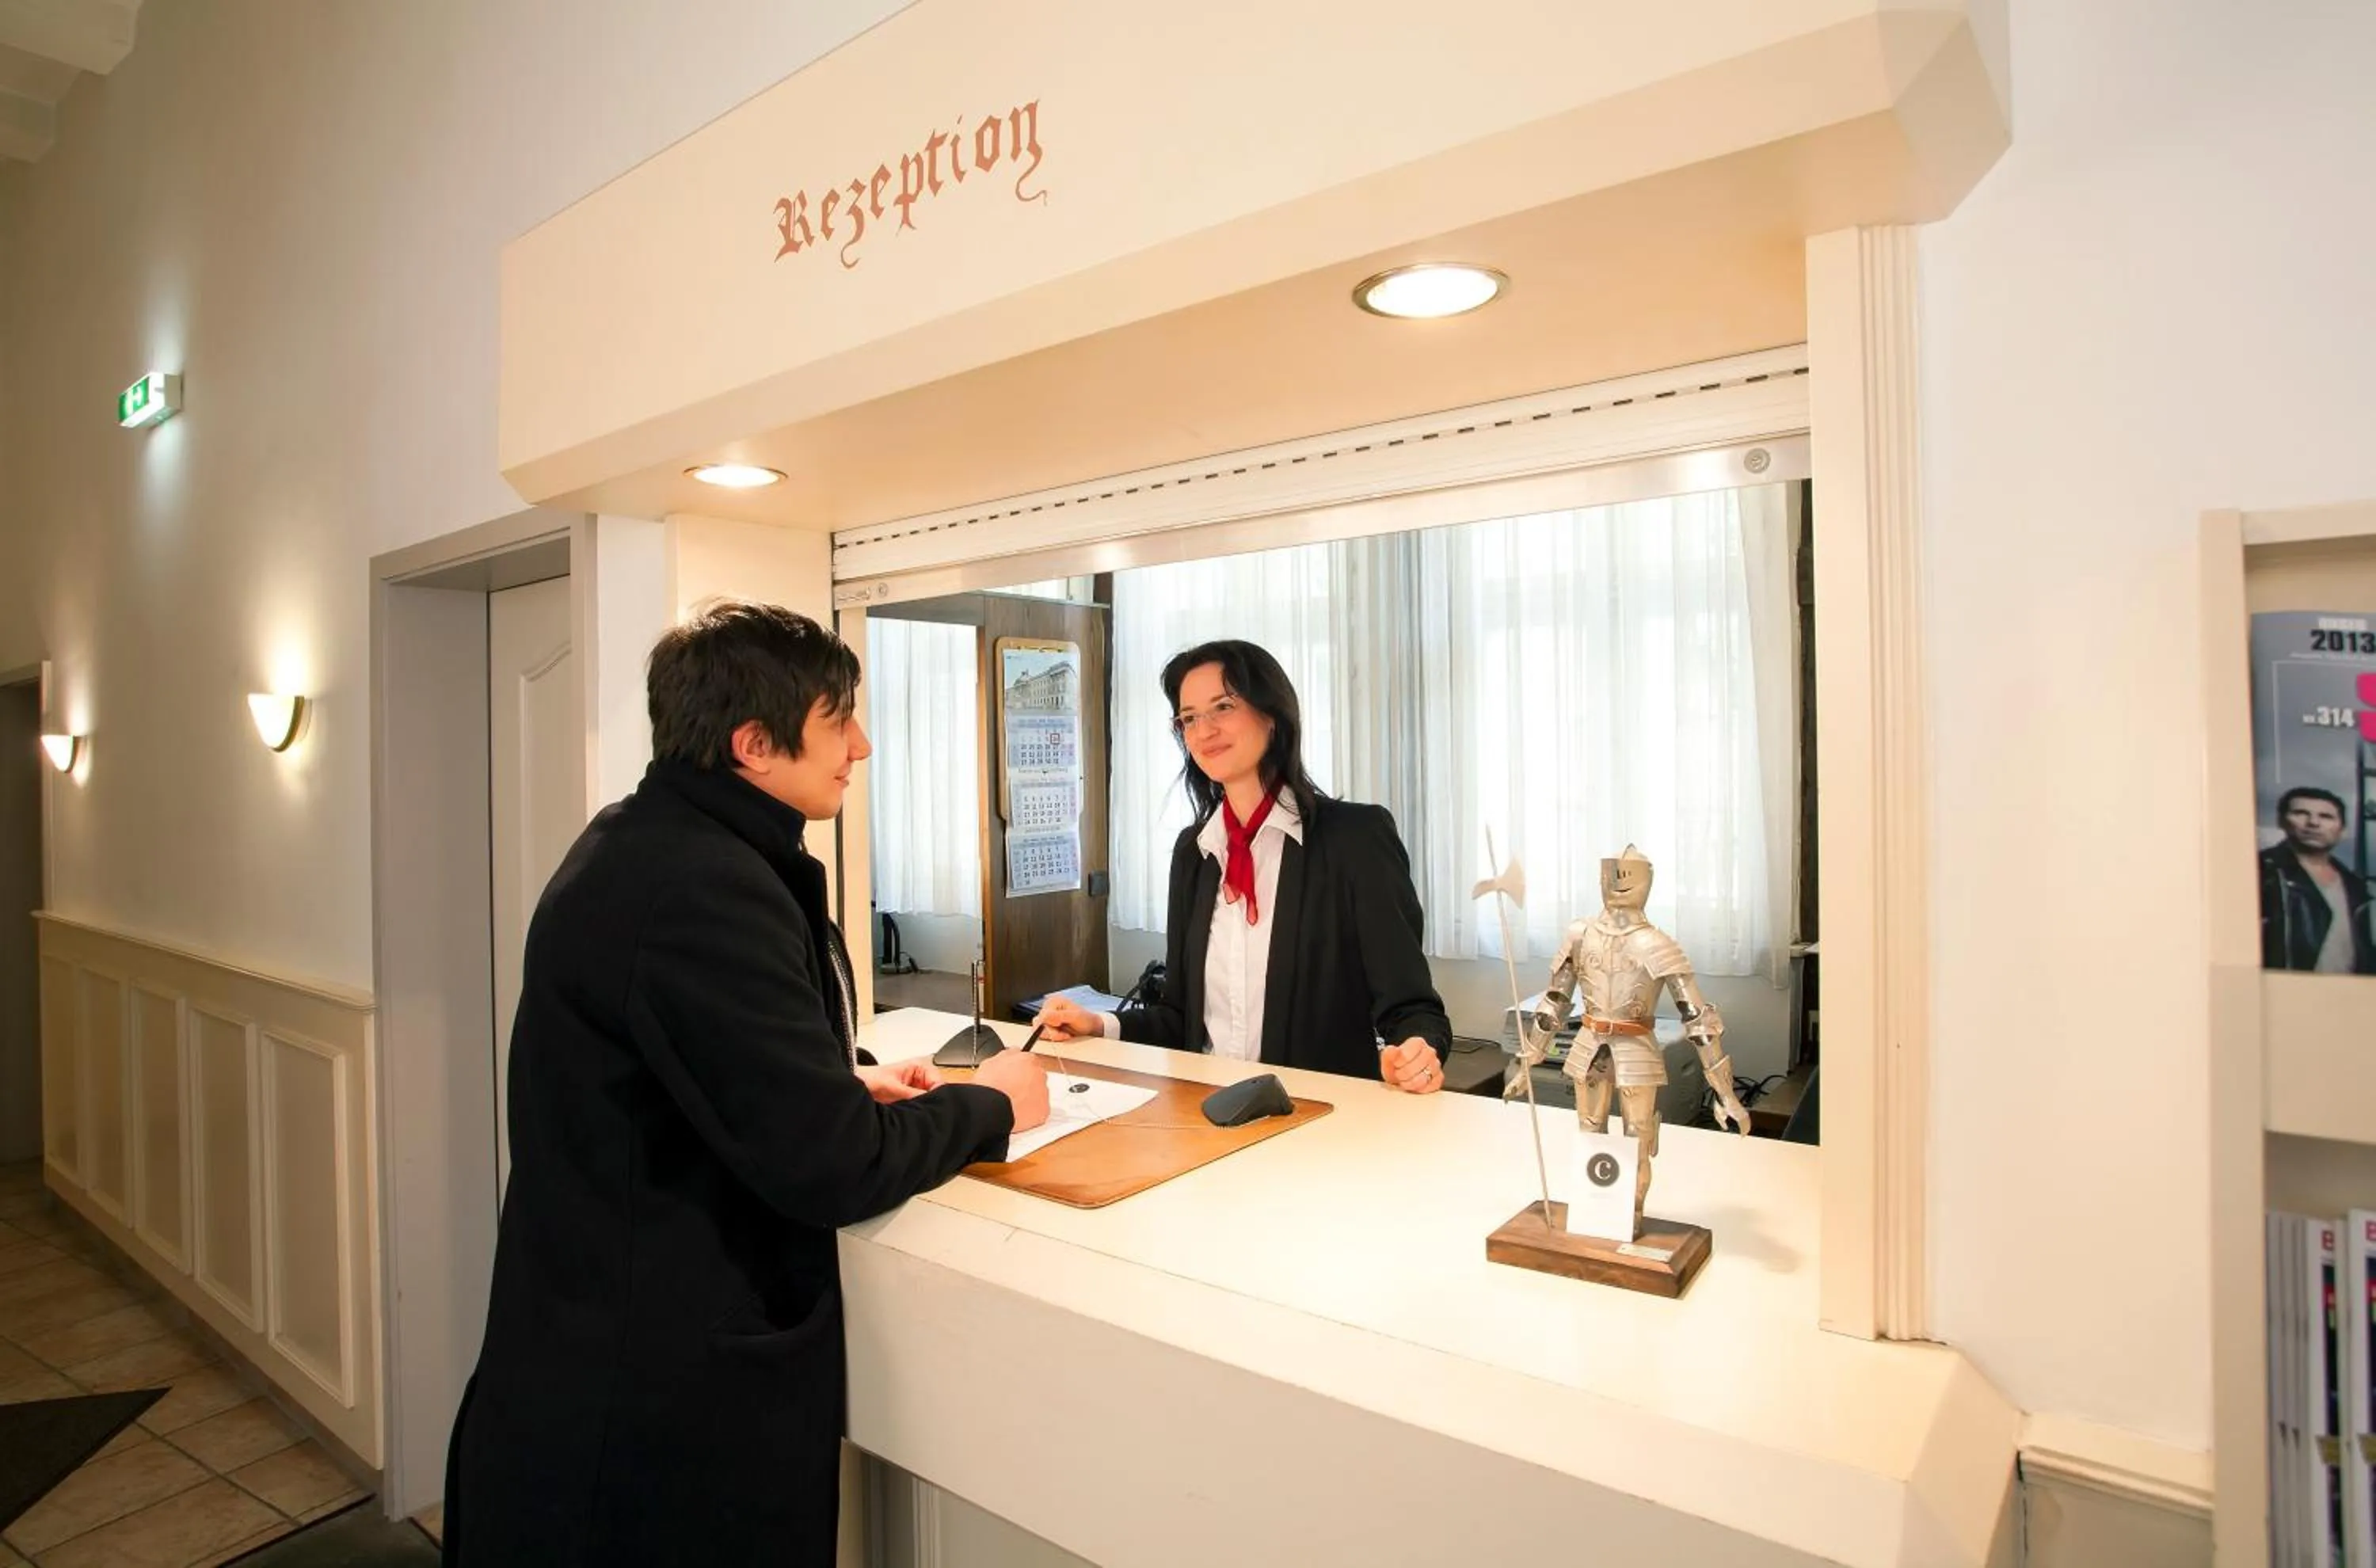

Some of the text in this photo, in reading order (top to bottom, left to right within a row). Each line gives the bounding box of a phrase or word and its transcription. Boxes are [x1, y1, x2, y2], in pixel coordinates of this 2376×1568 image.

[773, 99, 1048, 269] Rezeption
[2310, 629, 2376, 653] 2013
[2317, 706, 2355, 728] 314
[1594, 1160, 1612, 1180] C
